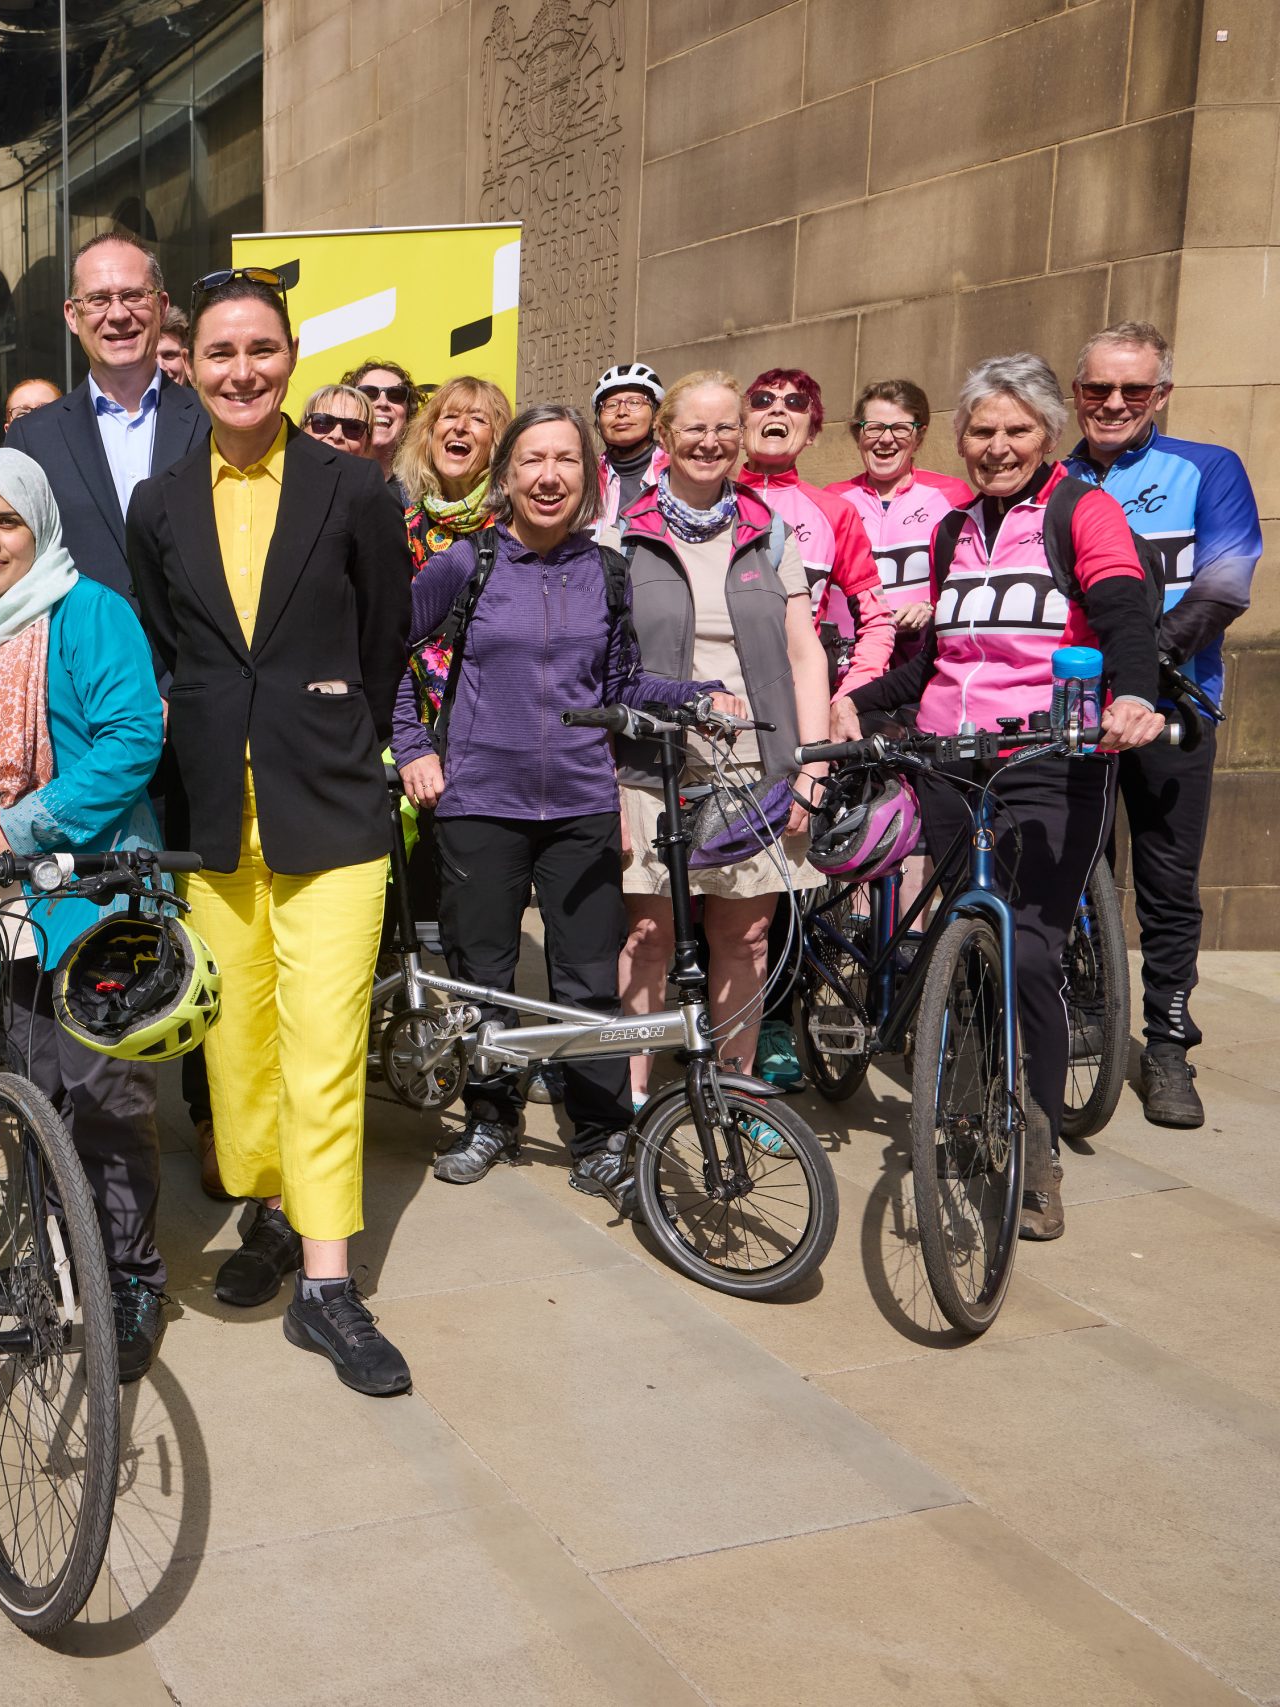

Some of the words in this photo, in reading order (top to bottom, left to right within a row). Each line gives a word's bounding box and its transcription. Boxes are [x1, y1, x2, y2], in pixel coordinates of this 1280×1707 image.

[479, 154, 574, 222] GEORGE
[601, 145, 625, 184] BY
[560, 199, 582, 229] OF
[584, 186, 622, 221] GOD
[520, 242, 547, 275] EAT
[550, 218, 620, 267] BRITAIN
[590, 252, 620, 287] THE
[541, 331, 569, 363] THE
[572, 320, 617, 356] SEAS
[600, 1025, 665, 1042] DAHON
